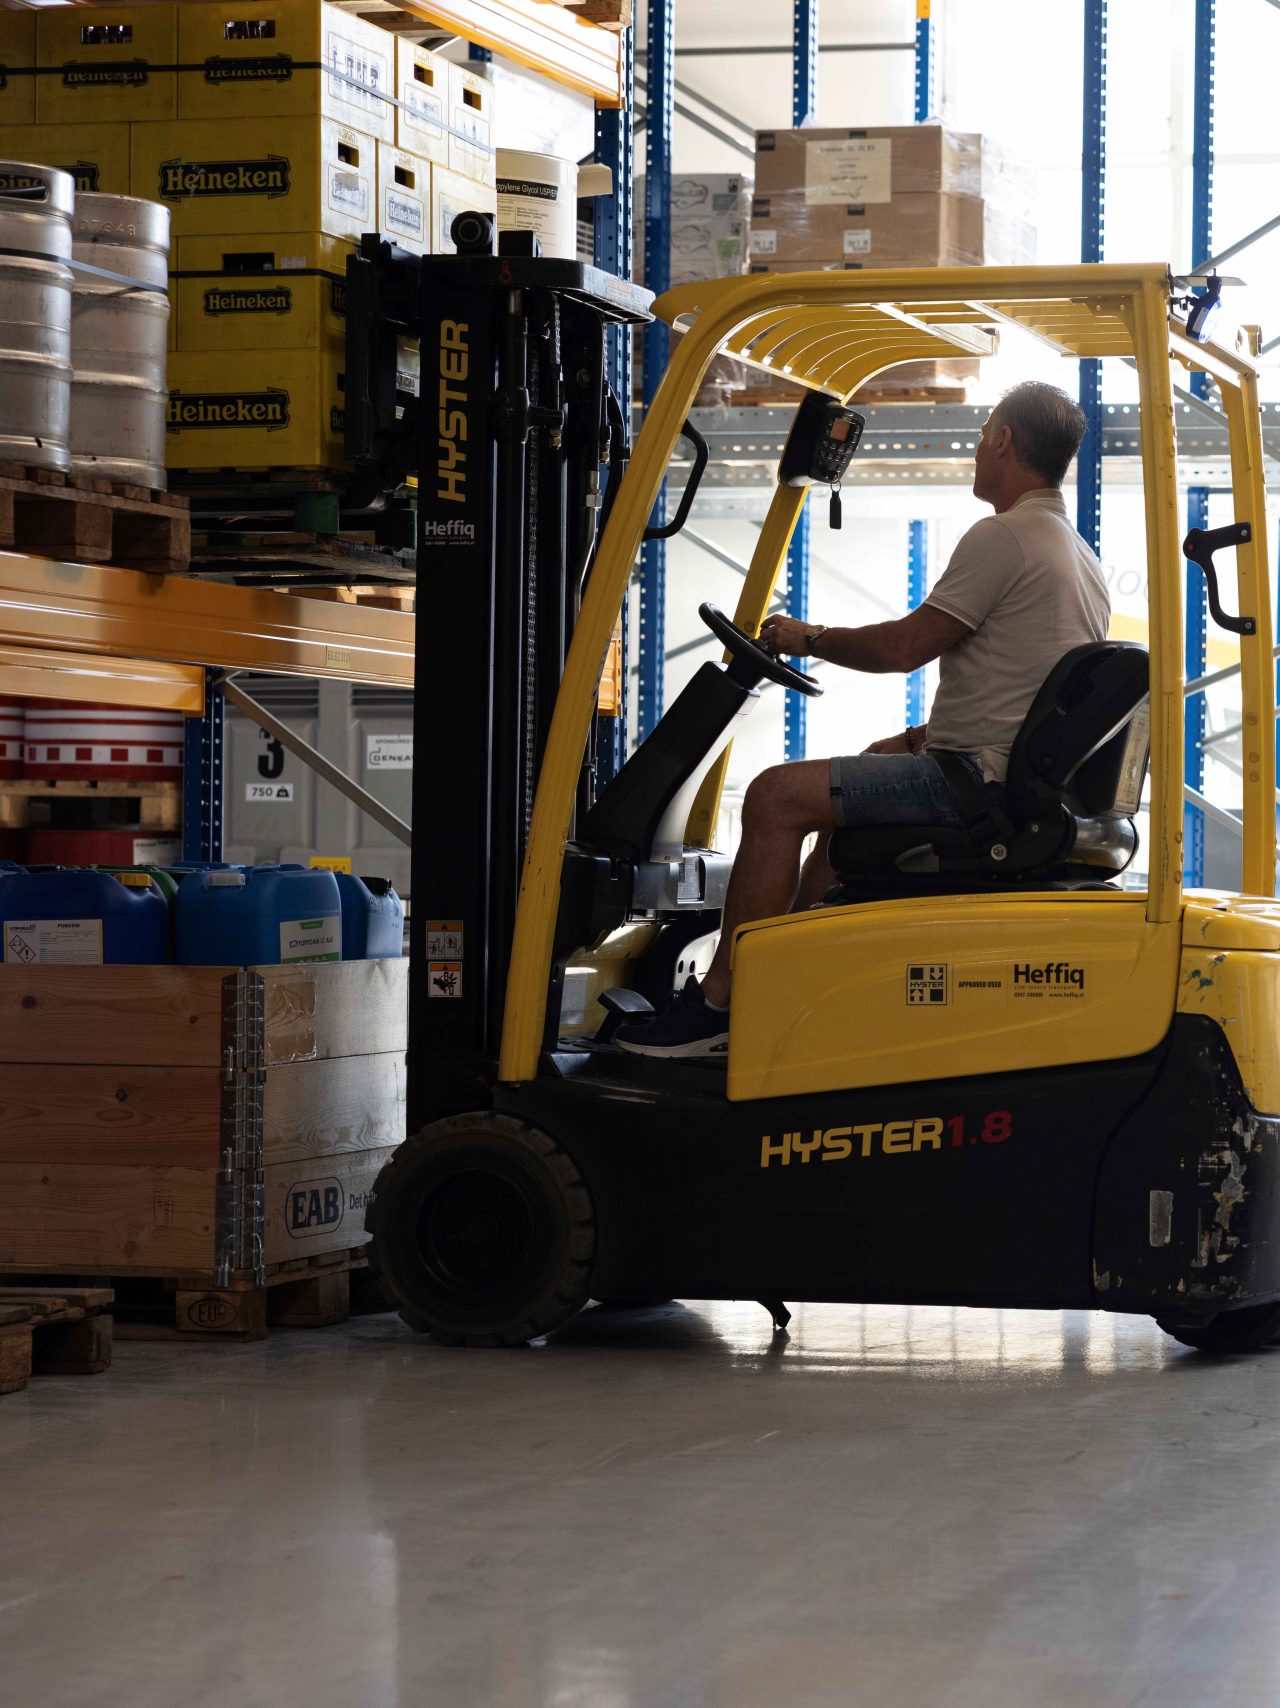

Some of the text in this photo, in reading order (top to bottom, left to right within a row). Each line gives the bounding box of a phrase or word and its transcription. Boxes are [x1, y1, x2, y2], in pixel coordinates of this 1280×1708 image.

[166, 167, 282, 192] Heineken
[496, 183, 520, 193] opylene
[521, 184, 539, 195] Glycol
[208, 293, 287, 311] Heineken
[166, 400, 282, 423] Heineken
[437, 319, 469, 504] HYSTER
[425, 519, 475, 540] Heffiq
[251, 787, 273, 798] 750
[1013, 962, 1085, 990] Heffiq
[760, 1110, 1013, 1168] HYSTER 1.8
[291, 1186, 339, 1230] EAB
